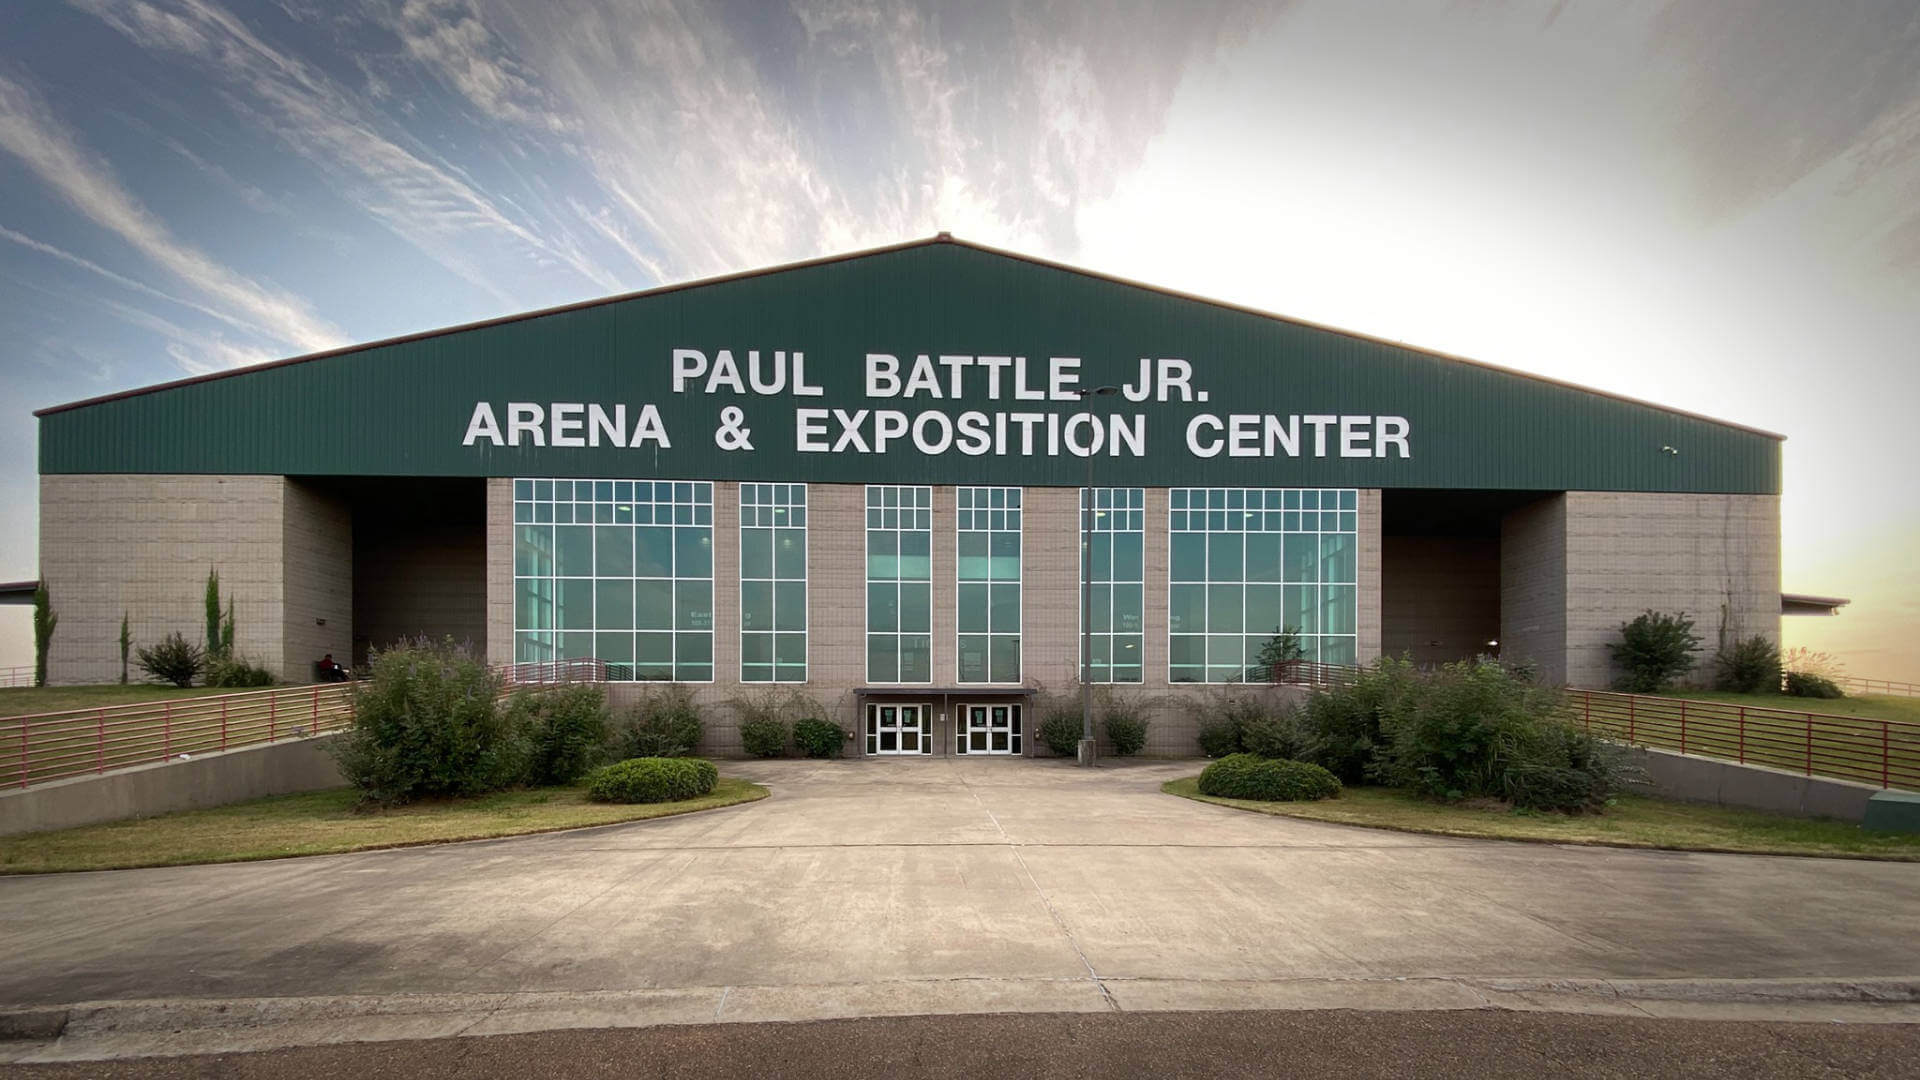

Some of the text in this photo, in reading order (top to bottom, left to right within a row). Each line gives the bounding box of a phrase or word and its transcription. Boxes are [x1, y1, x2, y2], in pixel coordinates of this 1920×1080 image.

[672, 349, 1209, 402] PAUL BATTLE JR.
[462, 402, 1411, 458] ARENA & EXPOSITION CENTER
